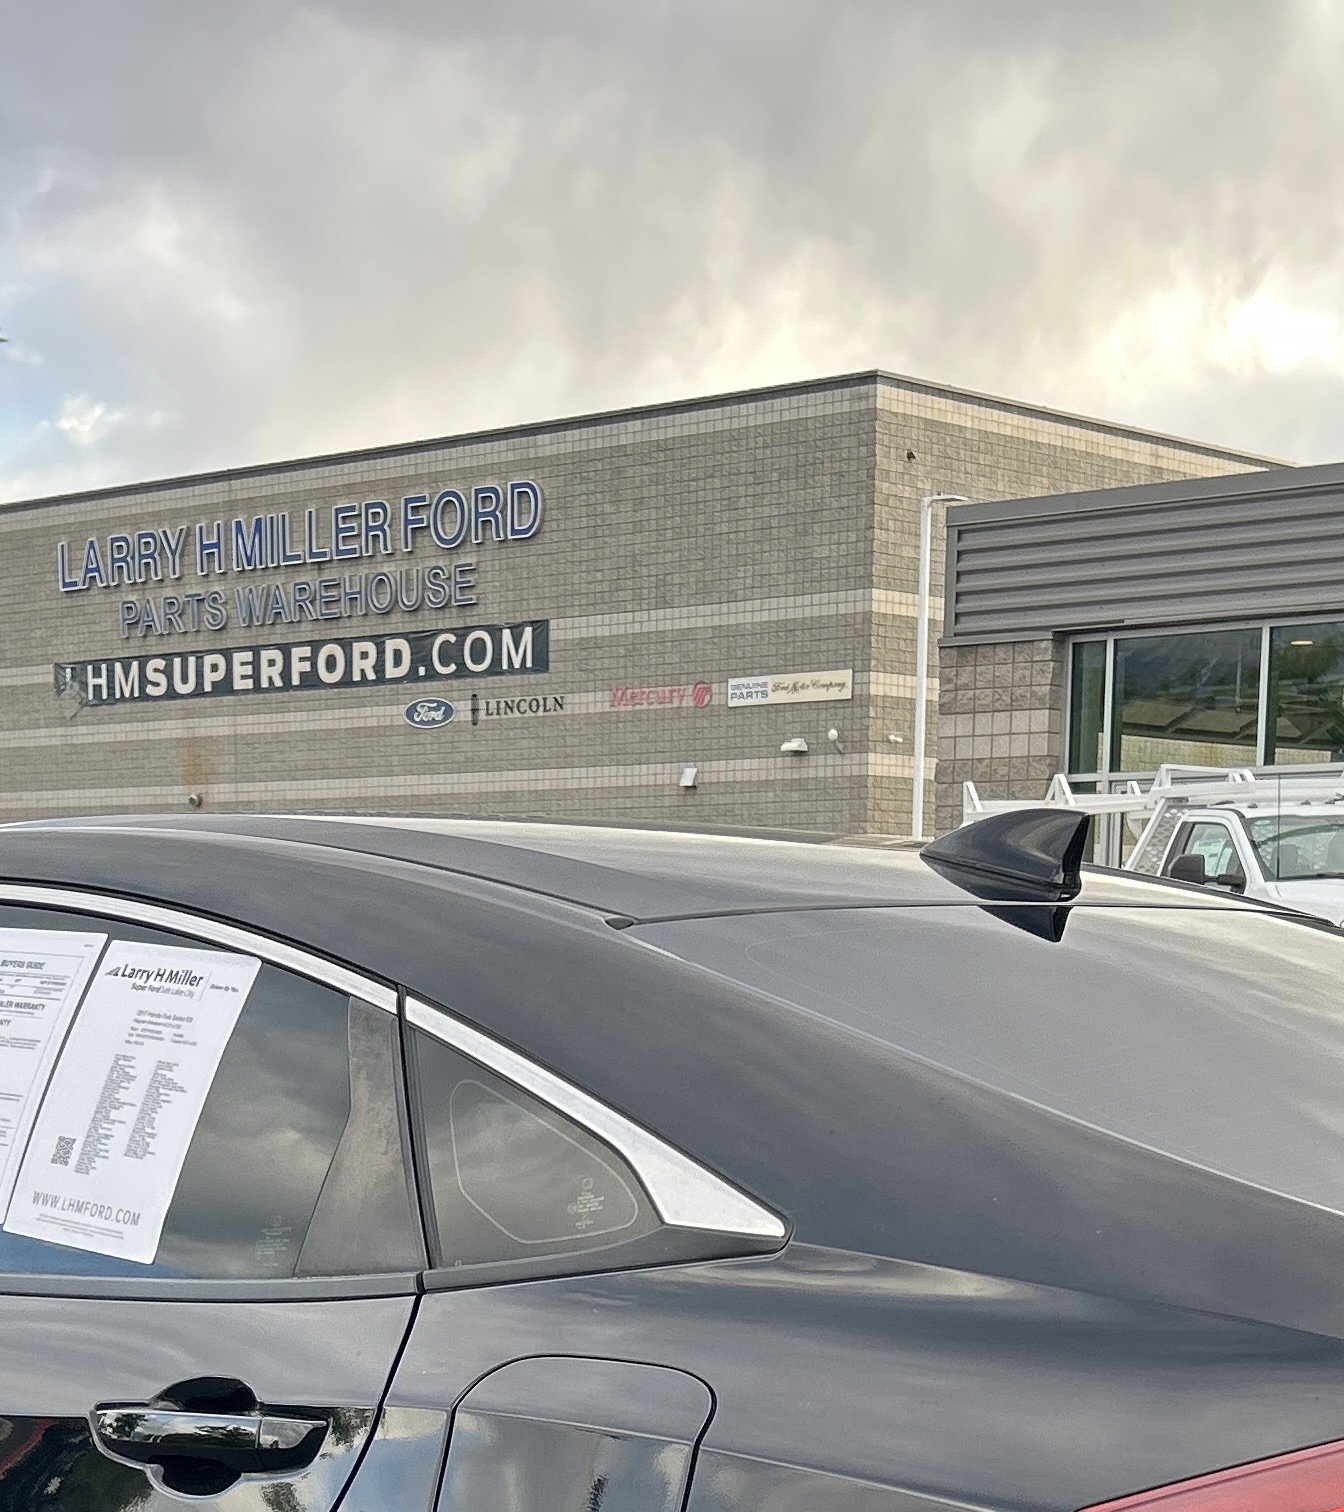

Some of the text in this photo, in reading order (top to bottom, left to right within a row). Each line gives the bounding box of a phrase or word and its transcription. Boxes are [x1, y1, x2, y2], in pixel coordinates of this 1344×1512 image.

[58, 480, 542, 592] LARRY H MILLER FORD
[120, 562, 477, 638] PARTS WAREHOUSE
[485, 696, 565, 716] LINCOLN
[610, 687, 687, 708] Mercury
[731, 690, 768, 700] PARTS
[413, 702, 446, 722] Ford
[121, 964, 204, 987] Larry H Miller
[33, 1190, 140, 1226] WWW.LHMFORD.COM
